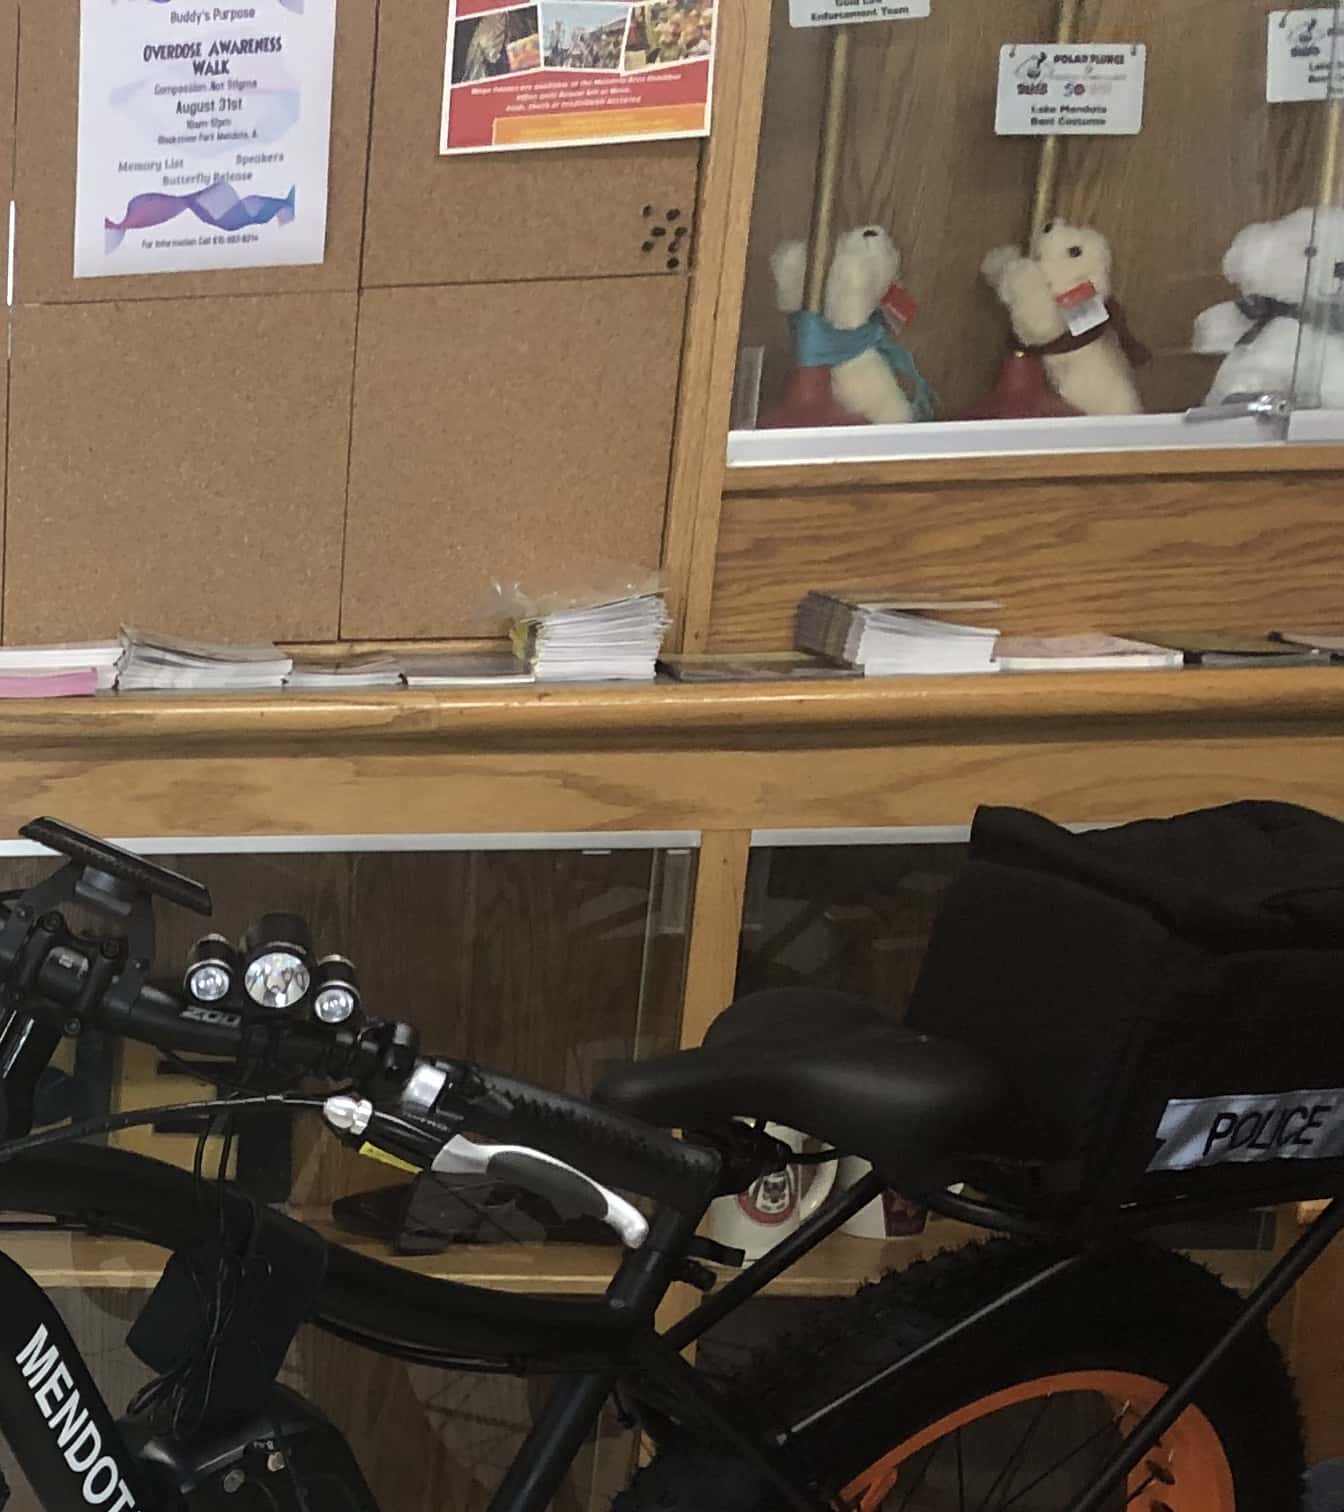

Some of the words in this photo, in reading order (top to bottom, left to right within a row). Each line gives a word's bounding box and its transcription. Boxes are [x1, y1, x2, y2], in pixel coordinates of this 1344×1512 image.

[170, 10, 211, 26] Buddy's
[213, 8, 255, 22] Purpose
[881, 6, 909, 17] Team
[143, 41, 202, 62] OVERDOSE
[208, 36, 282, 57] AWARENESS
[192, 59, 230, 76] WALK
[176, 98, 215, 117] August
[218, 97, 242, 112] 31st
[118, 159, 162, 173] Memory
[164, 158, 184, 170] List
[235, 153, 284, 167] Speakers
[162, 172, 211, 186] Butterfly
[213, 171, 253, 182] Release
[1202, 1103, 1333, 1157] POLICE
